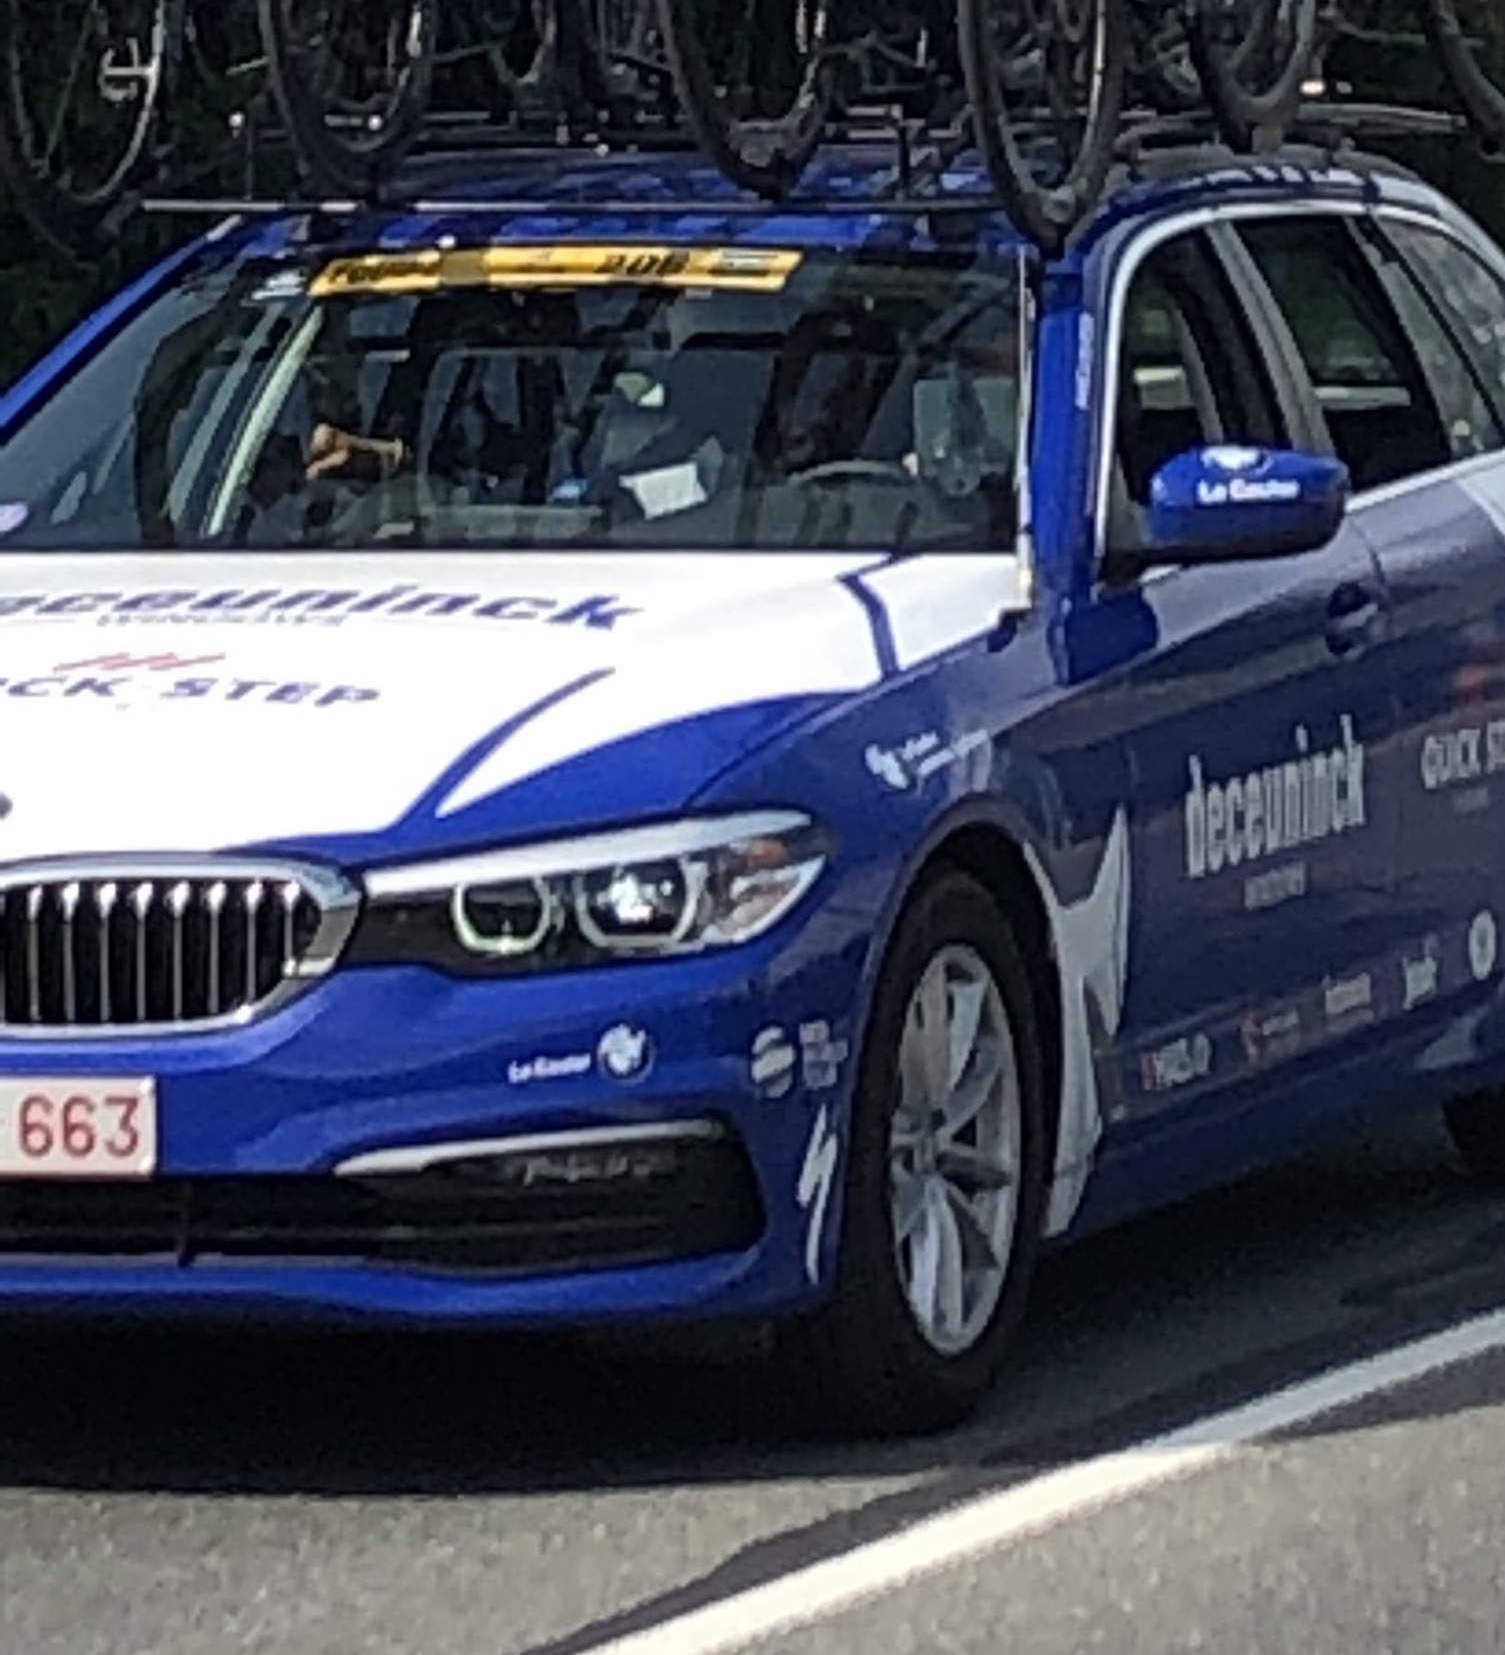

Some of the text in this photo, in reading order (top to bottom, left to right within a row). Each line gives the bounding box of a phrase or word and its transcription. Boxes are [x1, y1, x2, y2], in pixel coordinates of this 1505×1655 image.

[160, 676, 380, 707] STEP
[1185, 713, 1365, 879] deceuninck
[18, 1095, 139, 1159] 663
